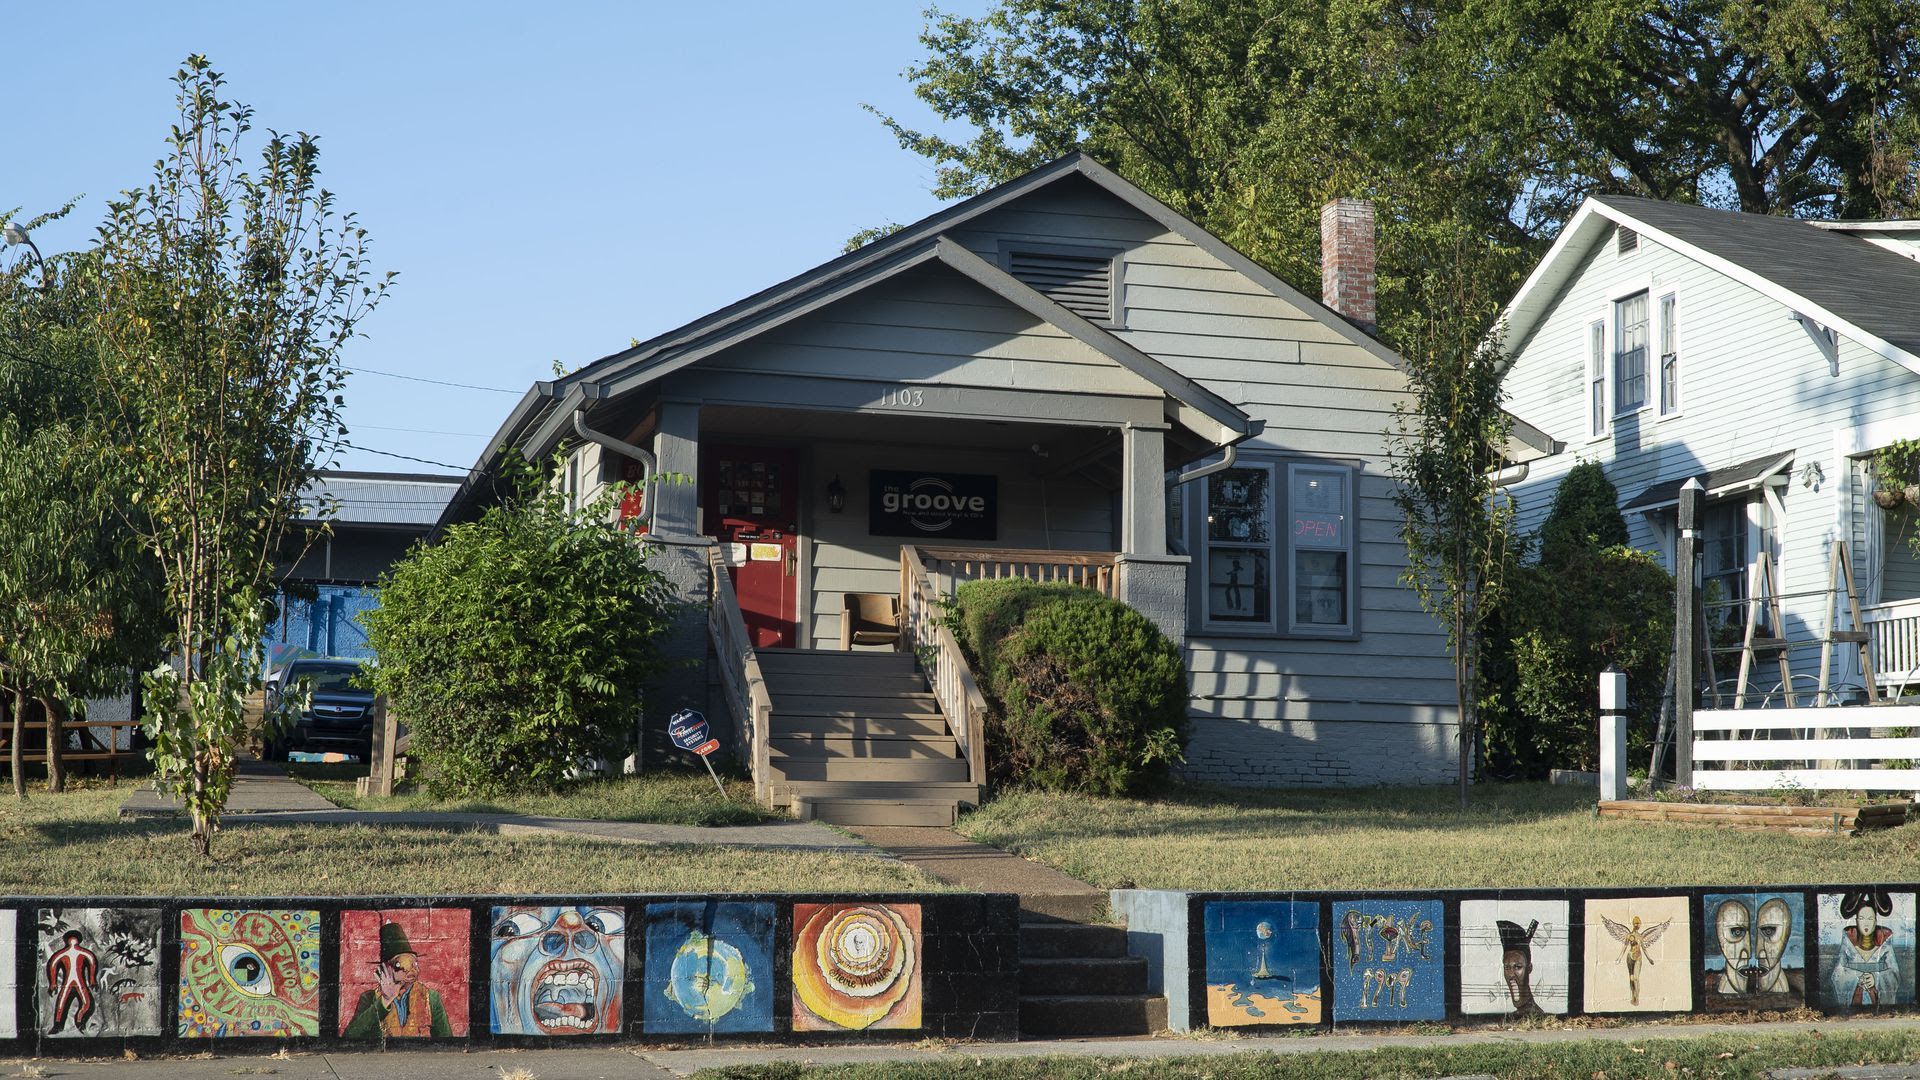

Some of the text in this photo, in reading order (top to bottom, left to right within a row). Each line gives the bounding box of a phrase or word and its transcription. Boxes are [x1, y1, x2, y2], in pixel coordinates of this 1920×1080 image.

[881, 388, 924, 407] 1103
[884, 485, 899, 493] the
[883, 493, 985, 512] groove
[1295, 519, 1337, 537] OPEN
[856, 967, 893, 988] Wonder
